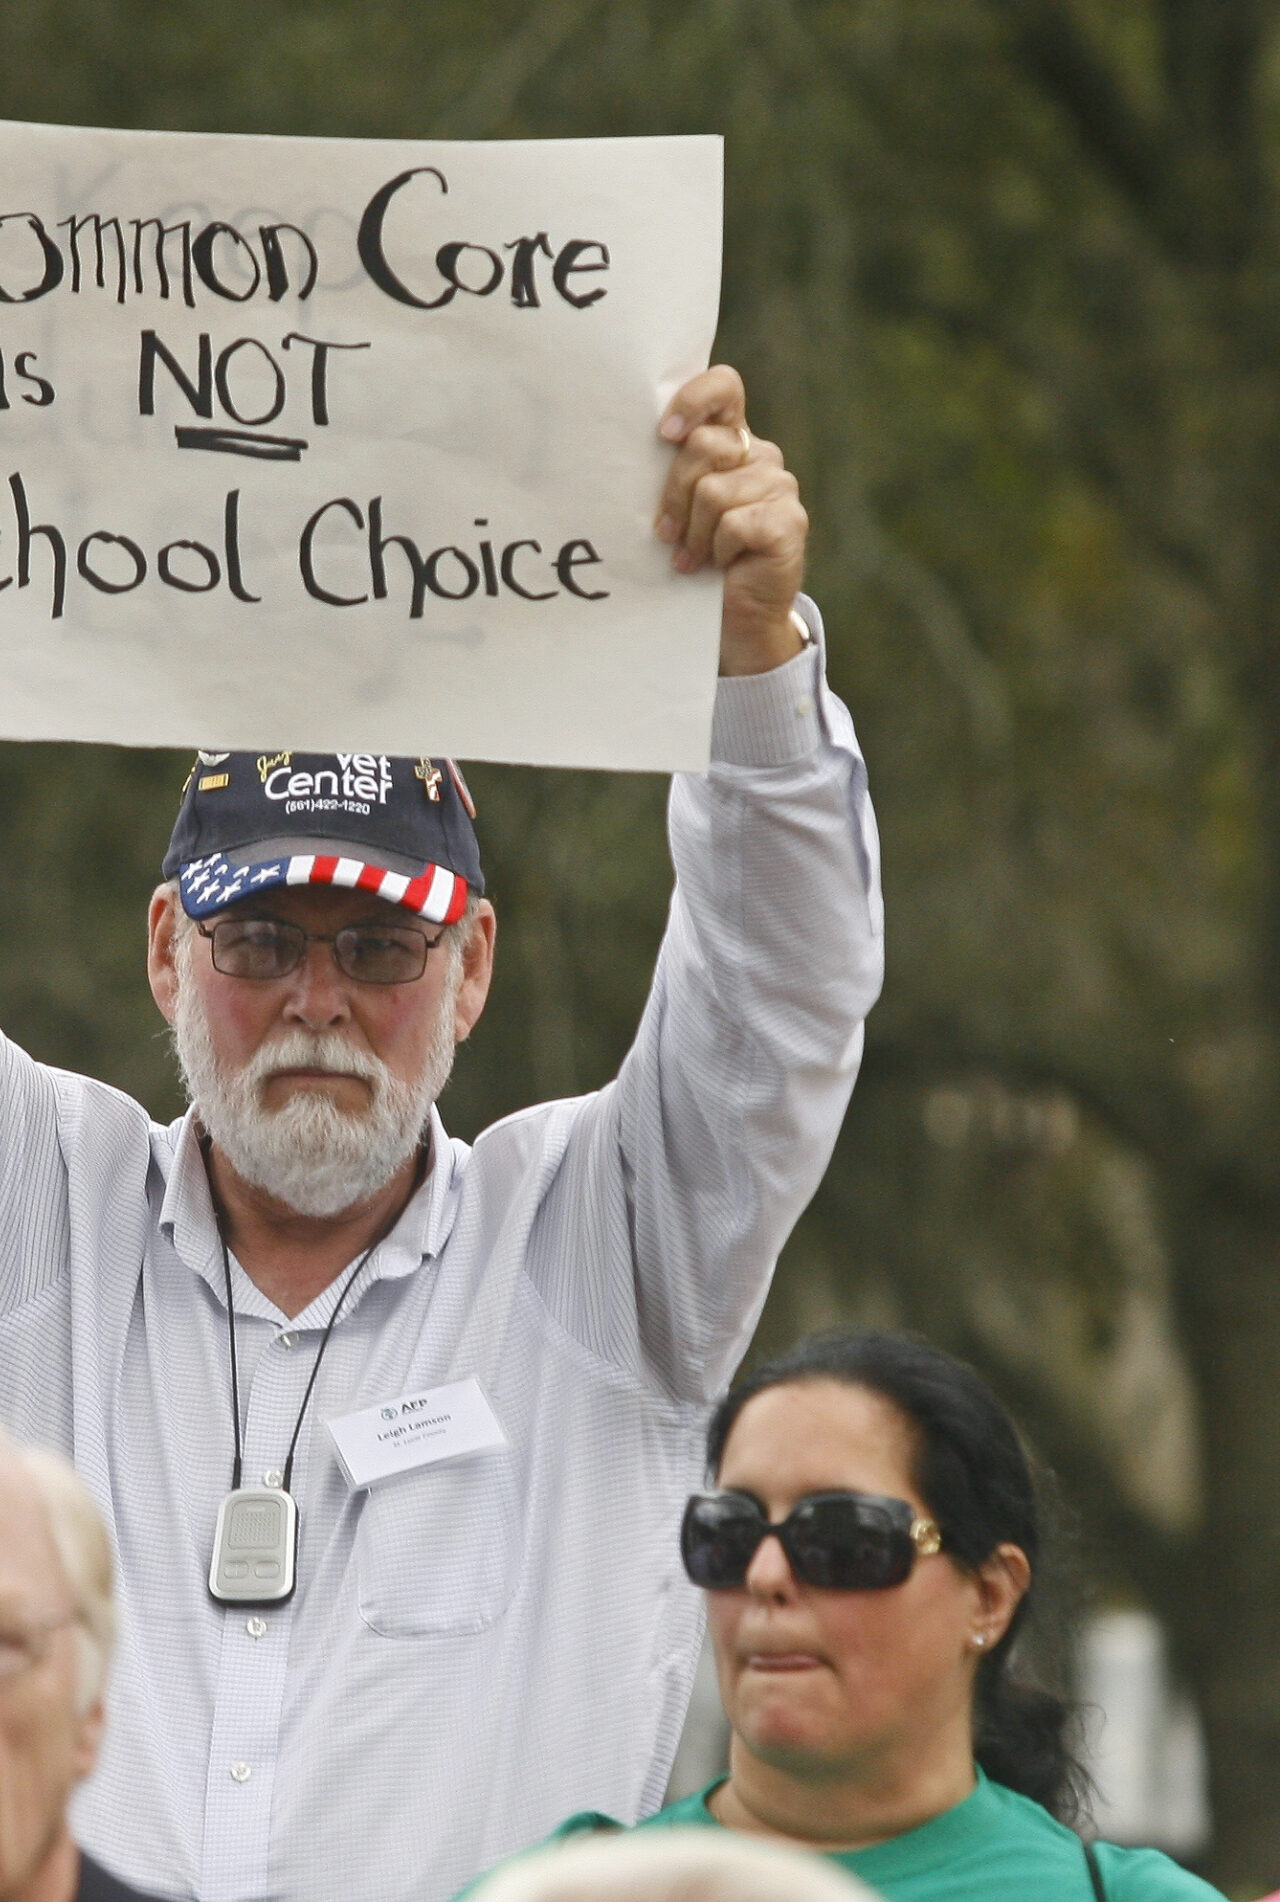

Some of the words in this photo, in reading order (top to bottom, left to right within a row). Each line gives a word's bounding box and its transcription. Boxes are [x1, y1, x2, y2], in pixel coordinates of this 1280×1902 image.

[356, 167, 609, 310] Core
[138, 329, 371, 427] NOT
[299, 496, 610, 619] Choice
[264, 766, 393, 804] Center
[336, 752, 393, 781] Vet
[377, 1427, 408, 1441] Leigh
[408, 1414, 452, 1431] Lamson
